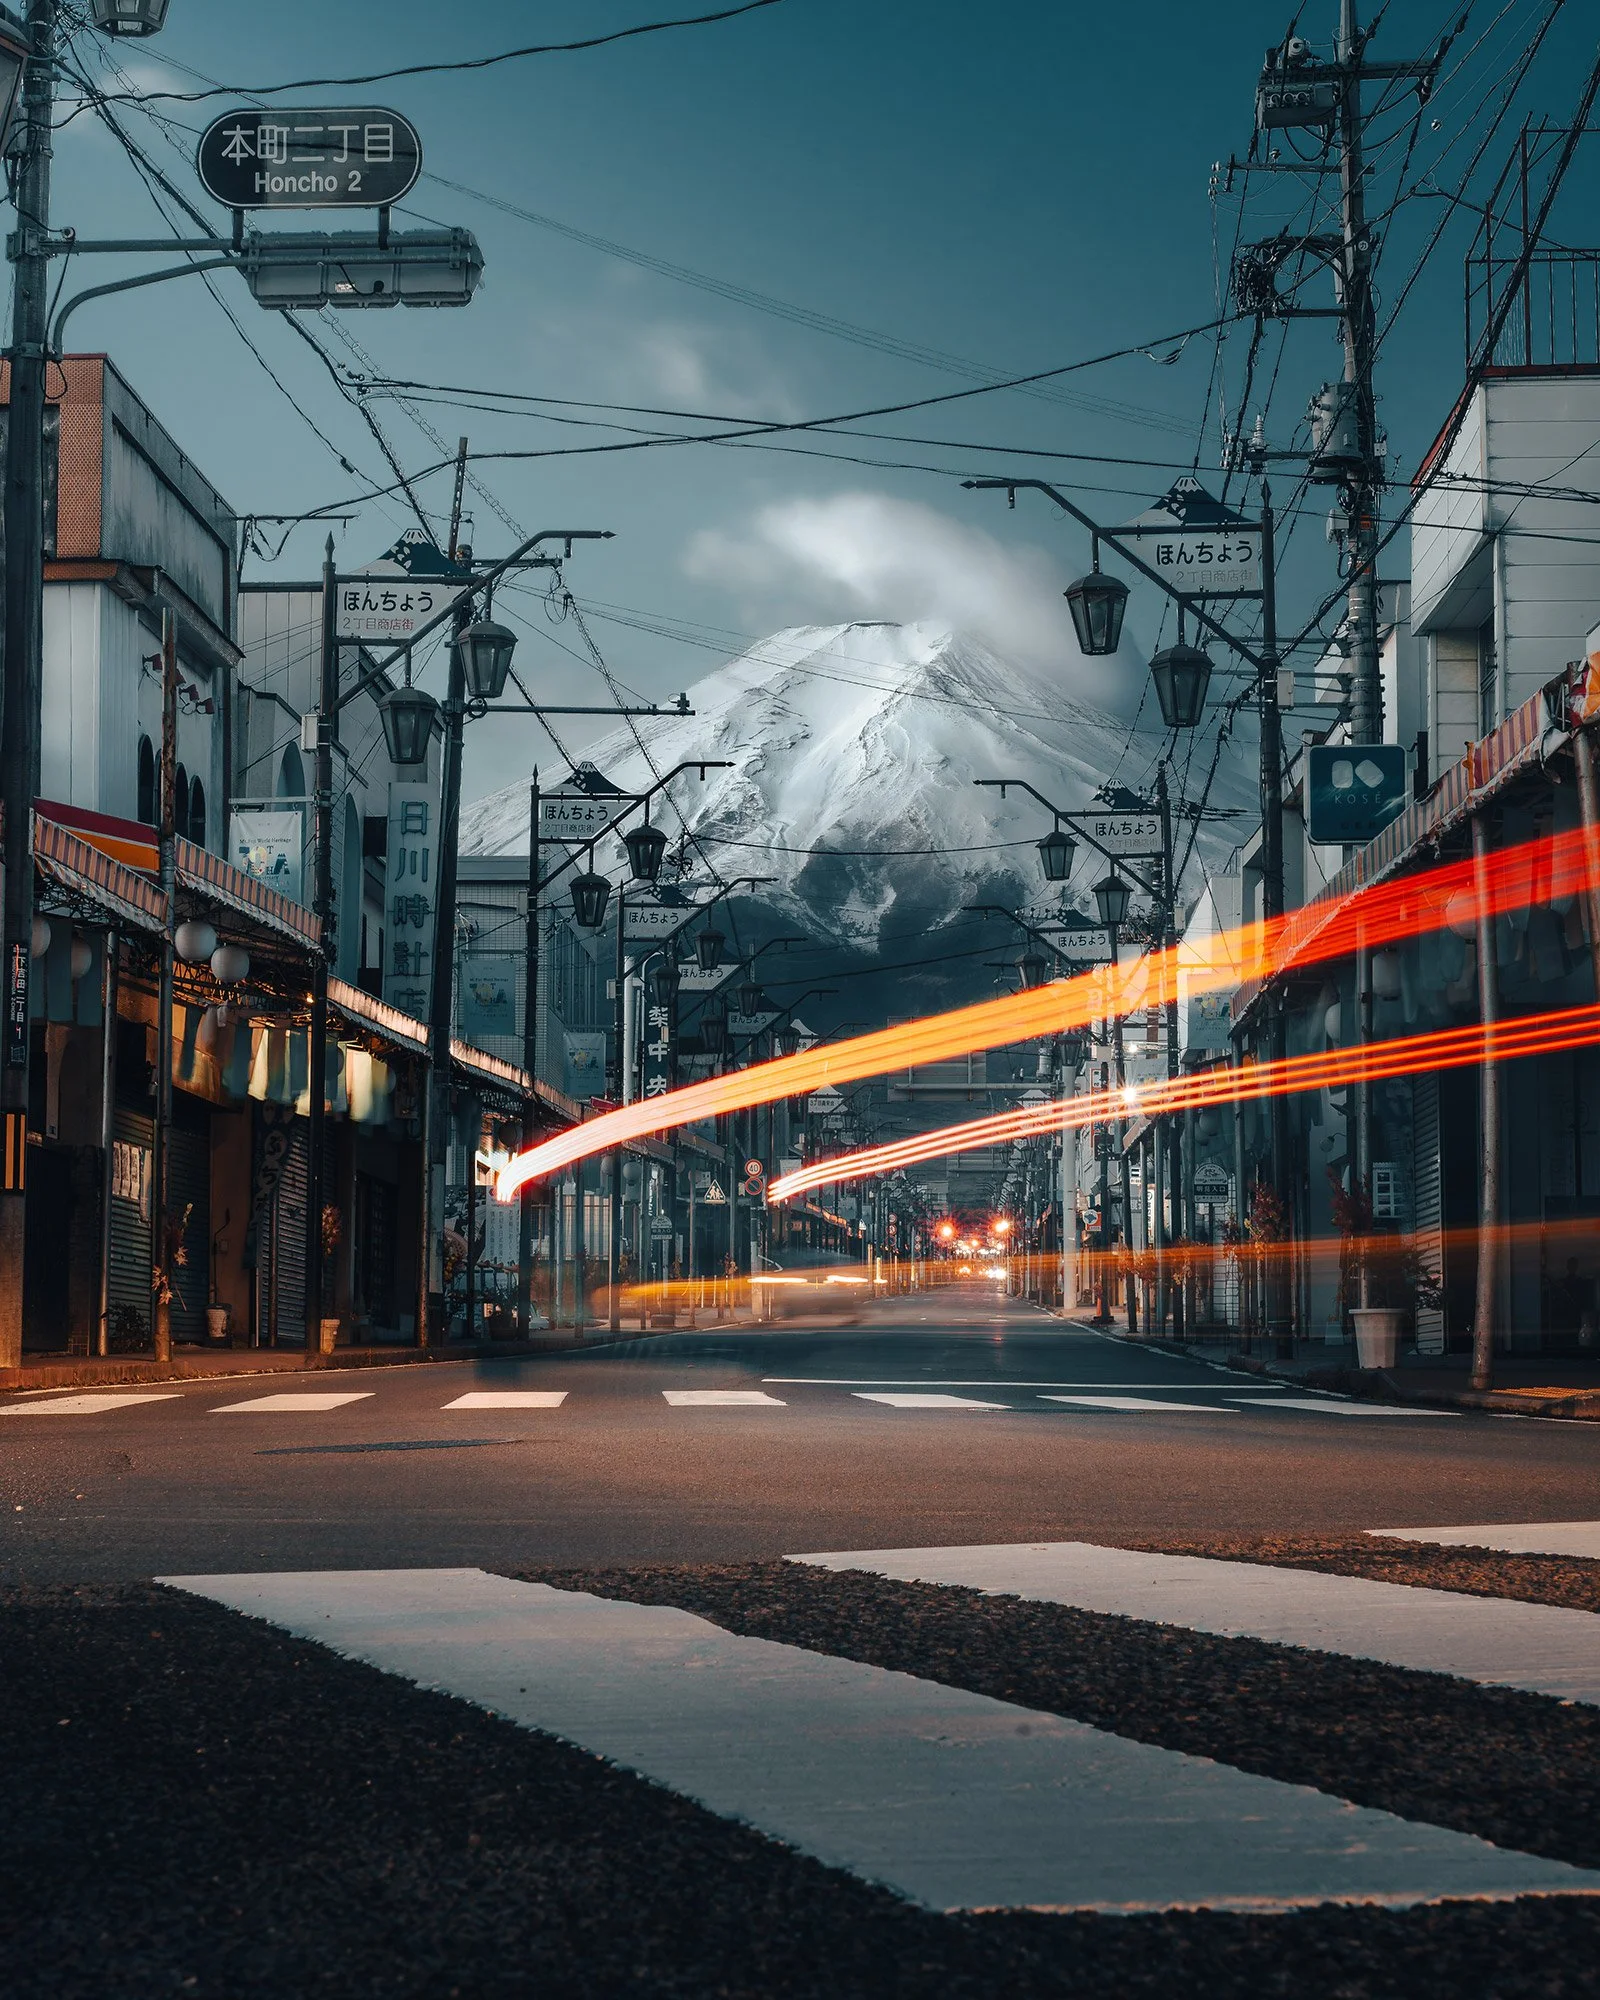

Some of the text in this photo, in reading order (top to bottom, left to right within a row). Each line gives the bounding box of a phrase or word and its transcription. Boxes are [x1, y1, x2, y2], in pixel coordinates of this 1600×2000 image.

[221, 123, 393, 166] 本町二丁目
[254, 170, 362, 193] Honcho 2
[1156, 540, 1253, 565] ほんちょう
[343, 590, 433, 612] ほんちょう
[342, 616, 414, 630] 2丁目商店街
[1334, 793, 1382, 804] KOSÉ
[545, 805, 608, 821] ほんちょう
[544, 824, 595, 833] 2丁目商店街
[1095, 820, 1157, 836] ほんちょう
[629, 912, 679, 924] ほんちょう
[1058, 933, 1106, 947] ほんちょう
[680, 967, 724, 978] ほんちょう
[731, 1015, 767, 1024] ほんちょう
[749, 1164, 759, 1172] 40
